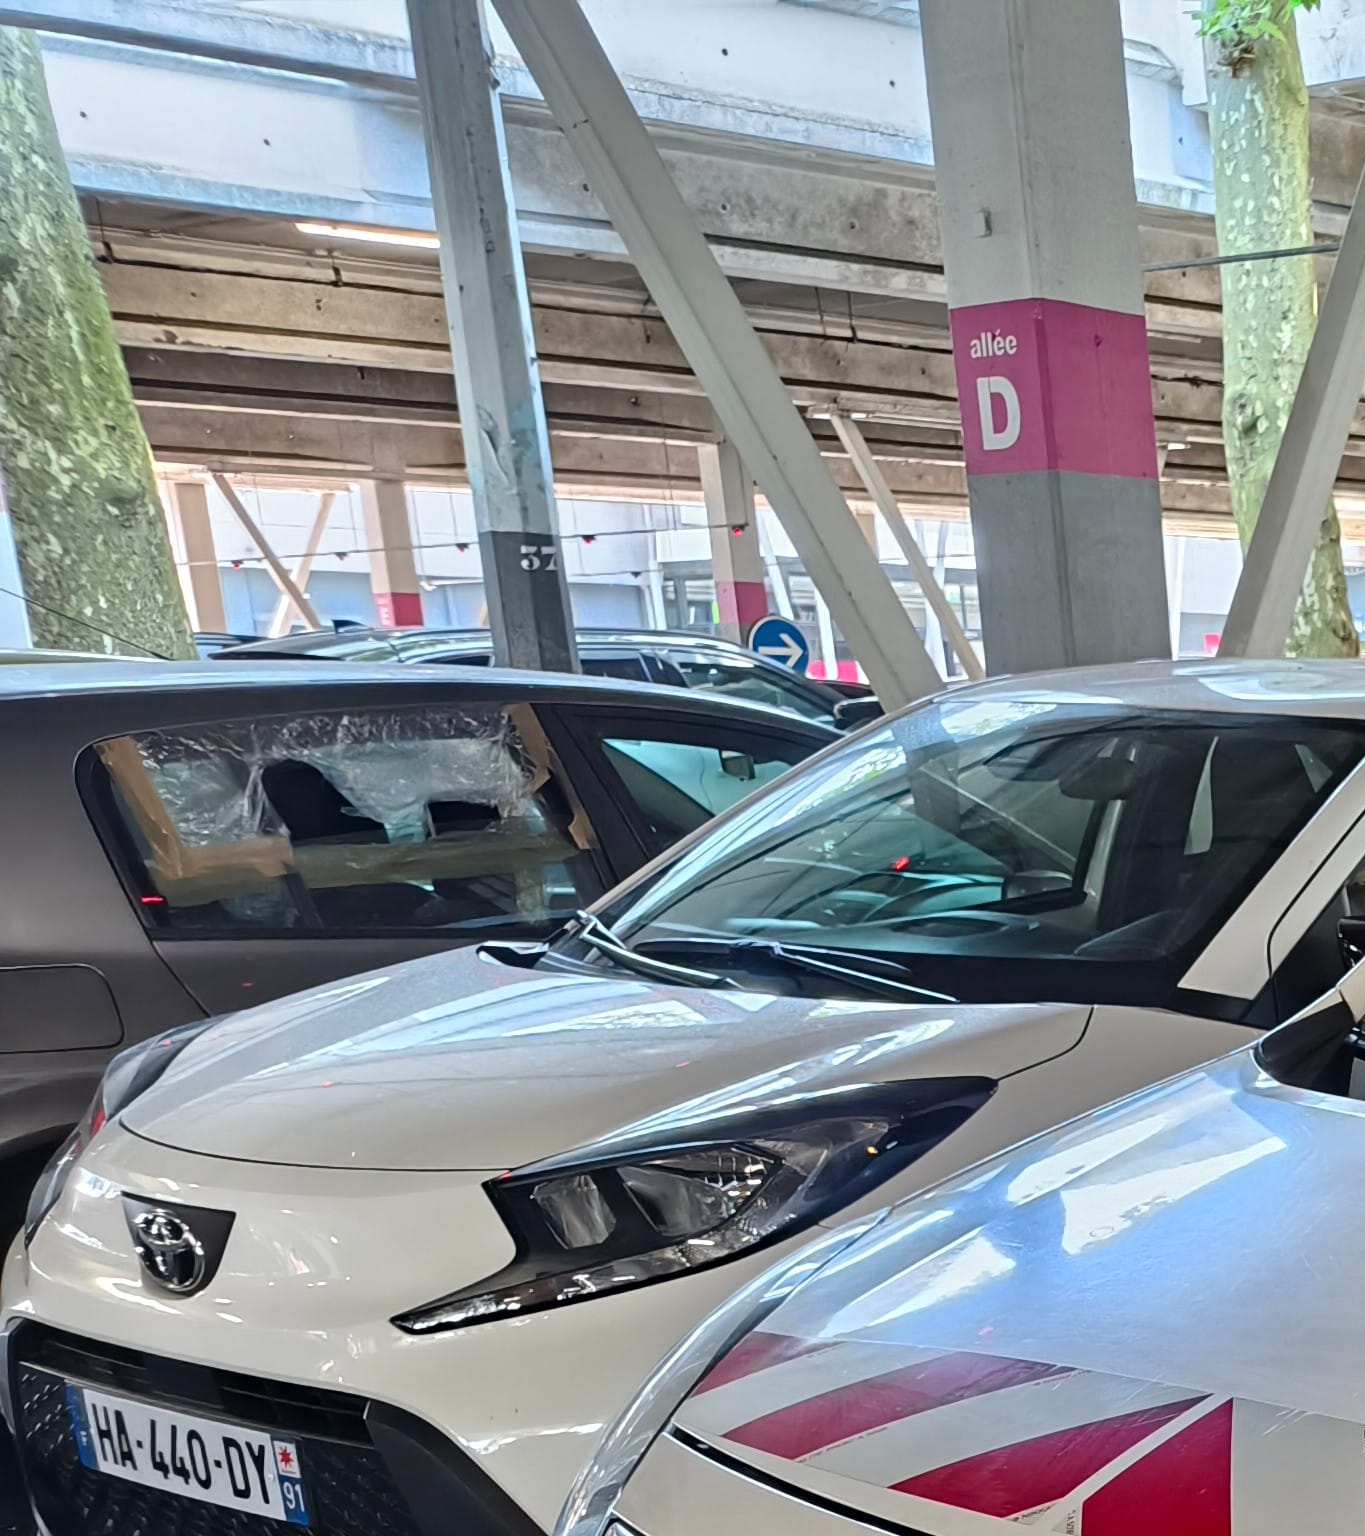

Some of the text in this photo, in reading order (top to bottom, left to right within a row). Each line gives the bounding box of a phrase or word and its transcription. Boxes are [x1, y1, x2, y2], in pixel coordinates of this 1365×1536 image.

[970, 328, 1017, 359] allée
[976, 375, 1021, 451] D
[91, 1402, 271, 1505] HA-440-DY
[283, 1480, 307, 1514] 91
